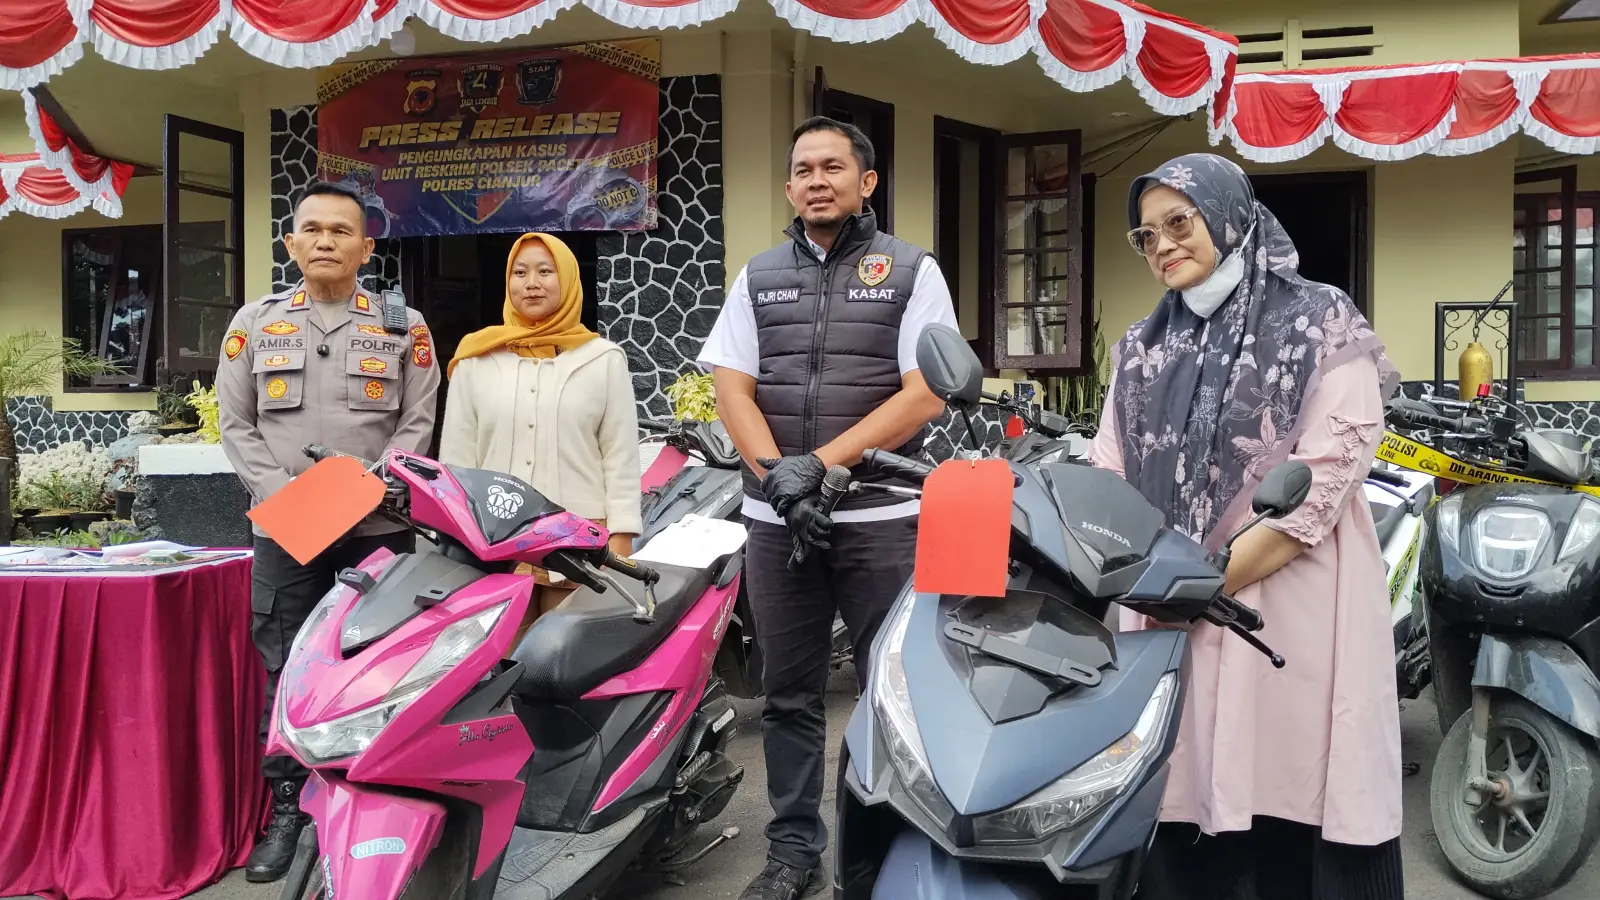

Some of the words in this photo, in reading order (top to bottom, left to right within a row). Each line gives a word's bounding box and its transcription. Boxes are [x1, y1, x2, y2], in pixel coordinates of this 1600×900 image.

[528, 65, 551, 74] SIAP
[317, 83, 338, 101] POLICE
[338, 75, 353, 88] LINE
[460, 98, 474, 108] JAGA
[359, 121, 463, 149] PRESS
[469, 111, 621, 141] RELEASE
[398, 146, 514, 165] PENGUNGKAPAN
[516, 142, 567, 158] KASUS
[608, 152, 635, 166] POLICE
[637, 145, 655, 159] LINE
[321, 158, 344, 170] POLICE
[381, 165, 411, 181] UNIT
[414, 162, 478, 179] RESKRIM
[479, 160, 534, 176] POLSEK
[421, 175, 474, 193] POLRES
[476, 173, 541, 189] CIANJUR
[611, 190, 628, 205] NOT
[757, 290, 776, 304] FAJRI
[776, 289, 799, 302] CHAN
[848, 288, 895, 301] KASAT
[258, 338, 303, 350] AMIR.S
[350, 339, 396, 353] POLRI
[1380, 435, 1417, 458] POLISI
[1380, 448, 1396, 460] LINE
[493, 475, 527, 491] HONDA
[1081, 520, 1132, 549] HONDA
[356, 839, 400, 857] NITRON
